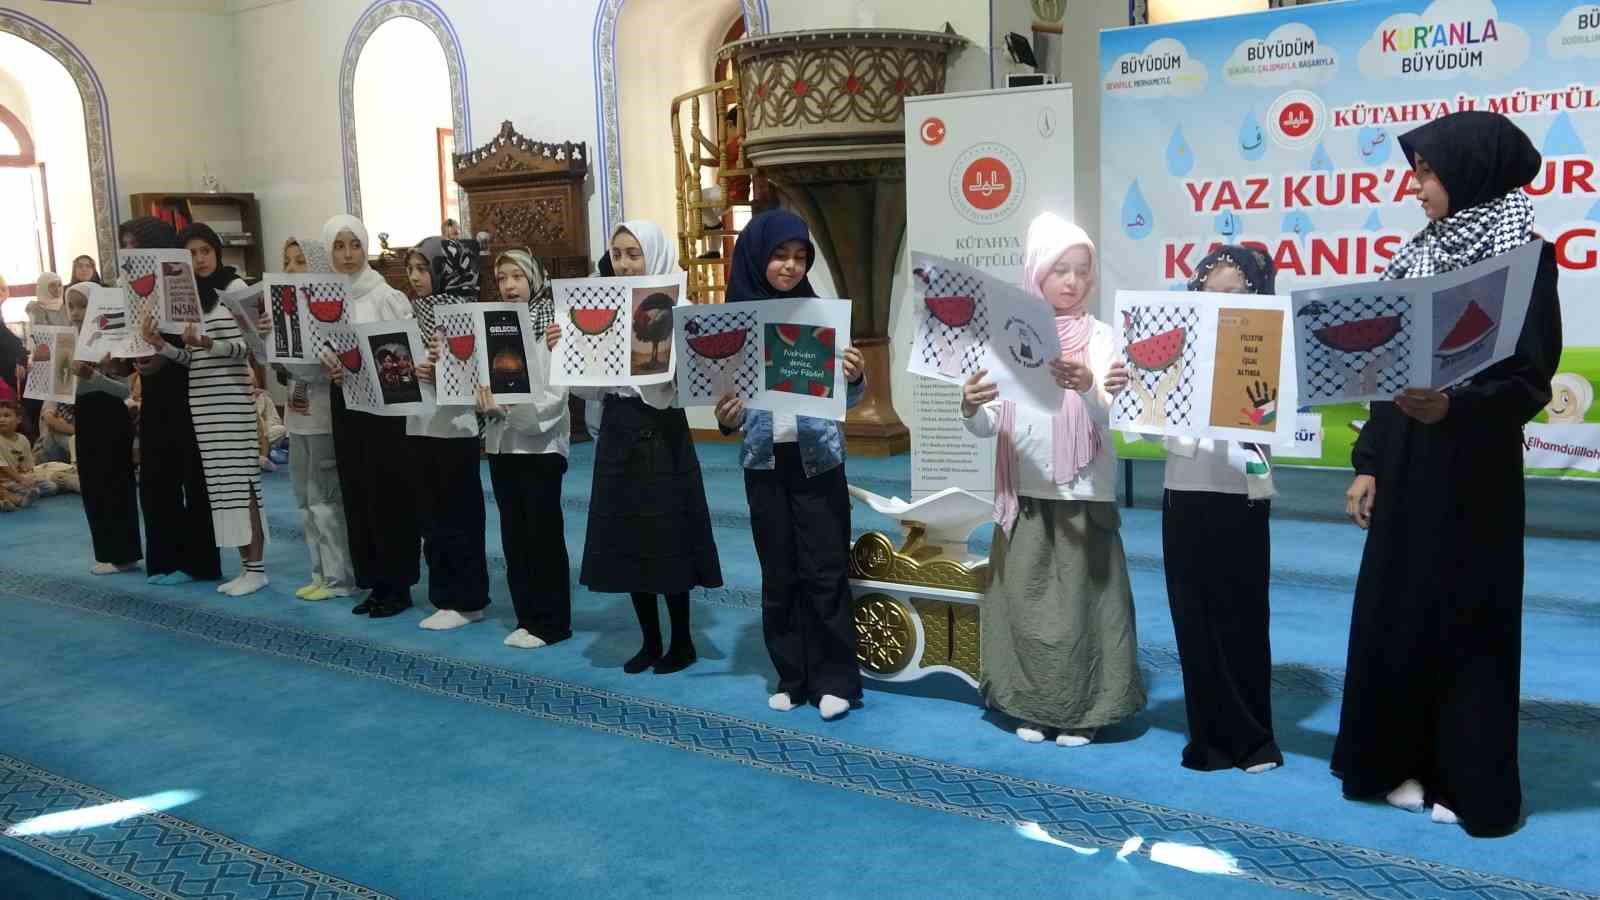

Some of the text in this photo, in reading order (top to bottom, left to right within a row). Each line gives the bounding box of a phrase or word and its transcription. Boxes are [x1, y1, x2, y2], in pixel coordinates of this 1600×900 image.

[1382, 18, 1498, 52] KUR'ANLA
[1247, 37, 1315, 61] BÜYÜDÜM
[1402, 47, 1482, 73] BÜYÜDÜM
[1121, 52, 1181, 75] BÜYÜDÜM
[1334, 101, 1452, 128] KÜTAHYA
[1186, 177, 1270, 213] YAZ
[1284, 167, 1418, 208] KUR'A
[956, 235, 1021, 250] KÜTAHYA
